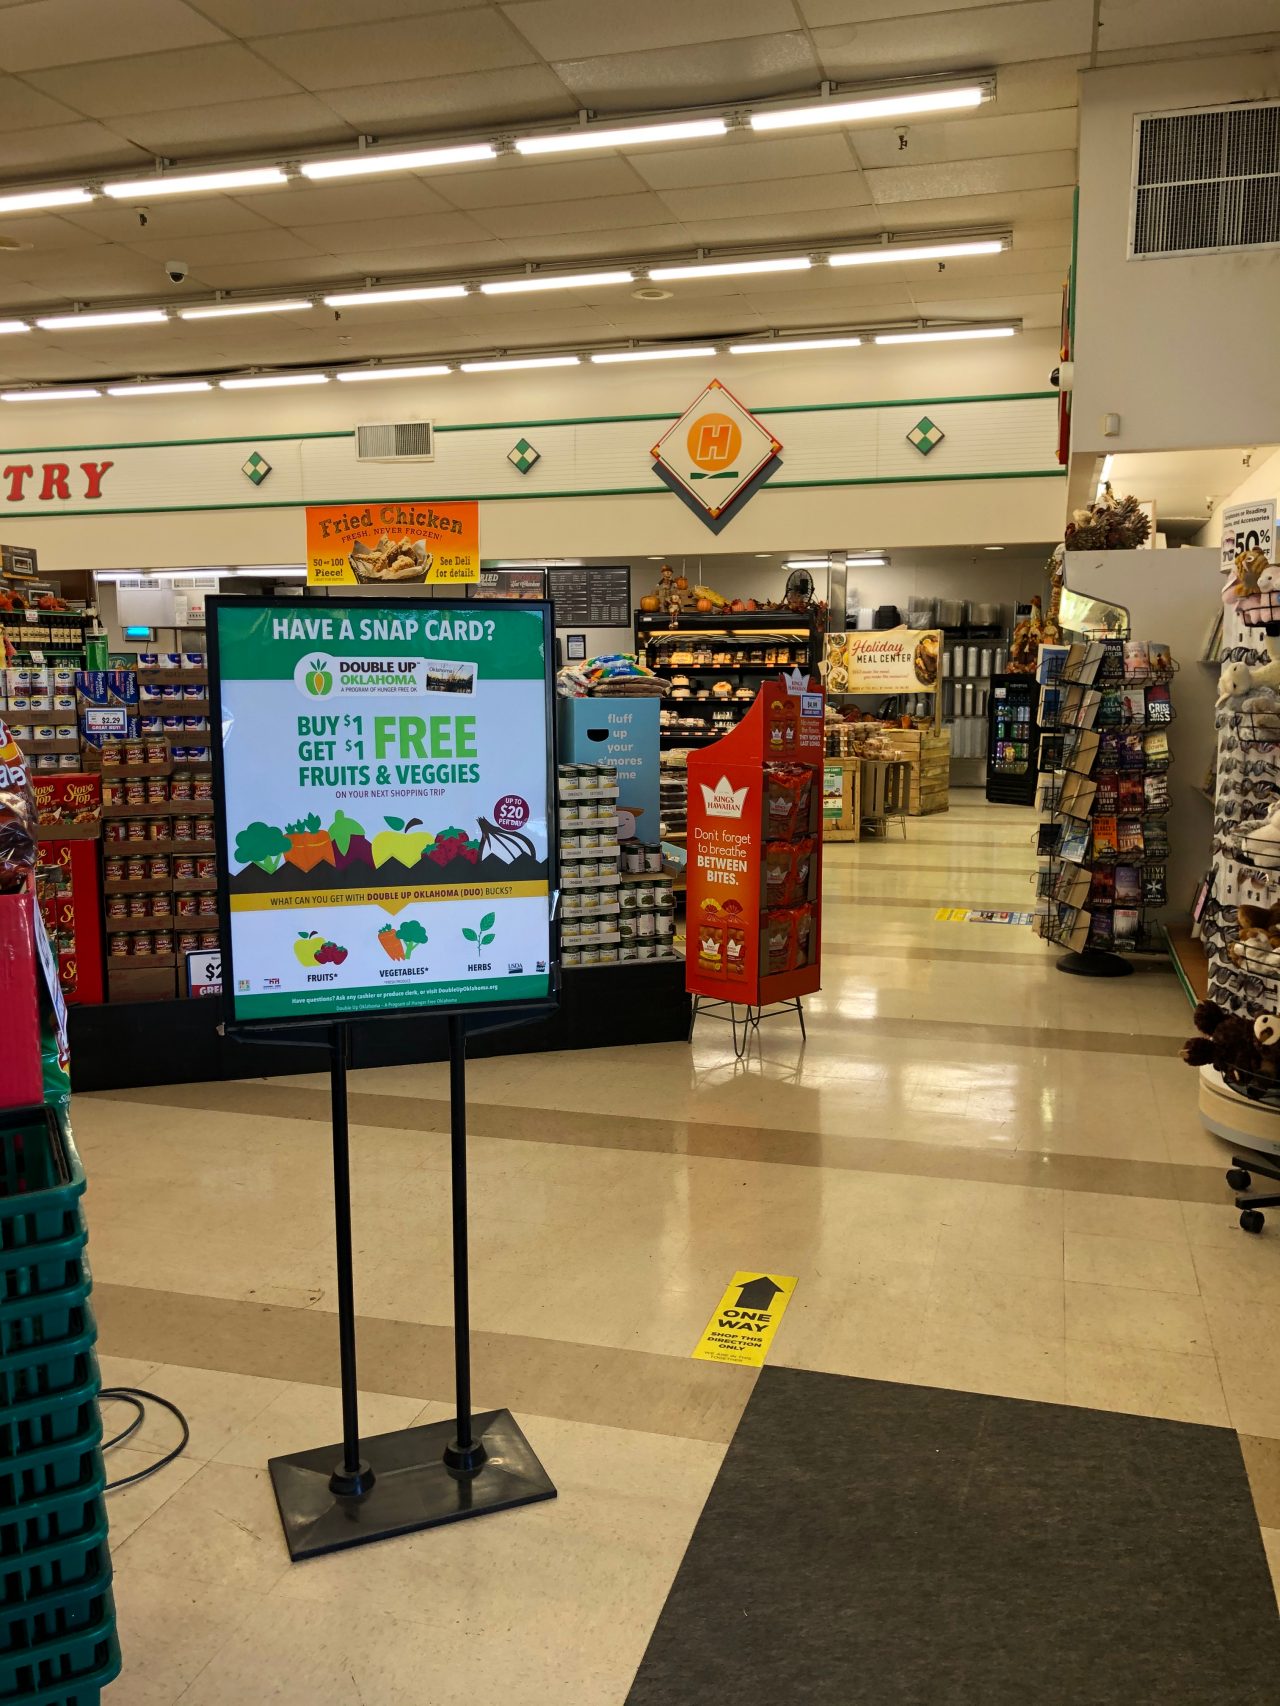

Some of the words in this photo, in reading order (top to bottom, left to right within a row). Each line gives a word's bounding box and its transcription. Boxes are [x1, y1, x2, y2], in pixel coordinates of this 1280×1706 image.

[1246, 507, 1267, 515] Reading
[319, 509, 373, 539] Fried
[380, 507, 463, 535] Chicken
[1241, 515, 1270, 524] Accessories
[374, 527, 402, 535] NEVER
[406, 527, 443, 541] FROZEN!
[313, 558, 323, 567] 50
[331, 558, 344, 567] 100
[440, 556, 453, 566] See
[455, 555, 471, 566] Deli
[315, 568, 343, 577] Piece!
[436, 568, 447, 579] for
[449, 567, 476, 578] details.
[272, 618, 333, 641] HAVE
[339, 619, 355, 641] A
[360, 619, 419, 641] SNAP
[425, 619, 496, 642] CARD?
[851, 640, 904, 657] Holiday
[856, 654, 877, 664] MEAL
[880, 653, 912, 663] CENTER
[339, 661, 395, 673] DOUBLE
[340, 674, 417, 686] OKLAHOMA
[1148, 702, 1170, 713] CRISS
[607, 713, 633, 724] fluff
[298, 716, 340, 737] BUY
[344, 714, 363, 736] $1
[374, 715, 478, 759] FREE
[612, 730, 628, 739] up
[298, 741, 337, 761] GET
[345, 739, 364, 760] $1
[607, 743, 634, 753] your
[299, 765, 371, 787] FRUITS
[375, 764, 392, 785] &
[395, 763, 481, 784] VEGGIES
[616, 771, 637, 779] ime
[33, 784, 55, 796] tove
[63, 783, 95, 802] Stove
[335, 791, 347, 799] ON
[348, 790, 369, 798] YOUR
[370, 789, 389, 798] NEXT
[390, 789, 429, 797] SHOPPING
[429, 788, 446, 796] TRIP
[75, 793, 91, 806] Top
[500, 803, 524, 819] $20
[707, 802, 740, 812] HAWAIIAN
[510, 819, 523, 827] DAY
[694, 827, 719, 841] Don't
[722, 829, 751, 846] forget
[698, 842, 708, 853] to
[709, 842, 747, 858] breathe
[697, 855, 747, 873] BETWEEN
[707, 870, 739, 886] BITES.
[270, 897, 293, 906] WHAT
[294, 896, 310, 905] CAN
[312, 895, 328, 904] YOU
[330, 894, 344, 903] GET
[345, 893, 365, 902] WITH
[367, 891, 399, 901] DOUBLE
[400, 891, 412, 899] UP
[413, 889, 459, 899] OKLAHOMA
[460, 888, 484, 897] (DUO)
[485, 887, 513, 896] BUCKS?
[467, 963, 492, 972] HERBS
[199, 985, 222, 996] GRE
[306, 996, 335, 1004] questions?
[383, 991, 404, 999] produce
[723, 1309, 772, 1323] ONE
[718, 1319, 769, 1332] WAY
[711, 1331, 739, 1339] SHOP
[707, 1336, 762, 1348] DIRECTION
[718, 1343, 746, 1351] ONLY
